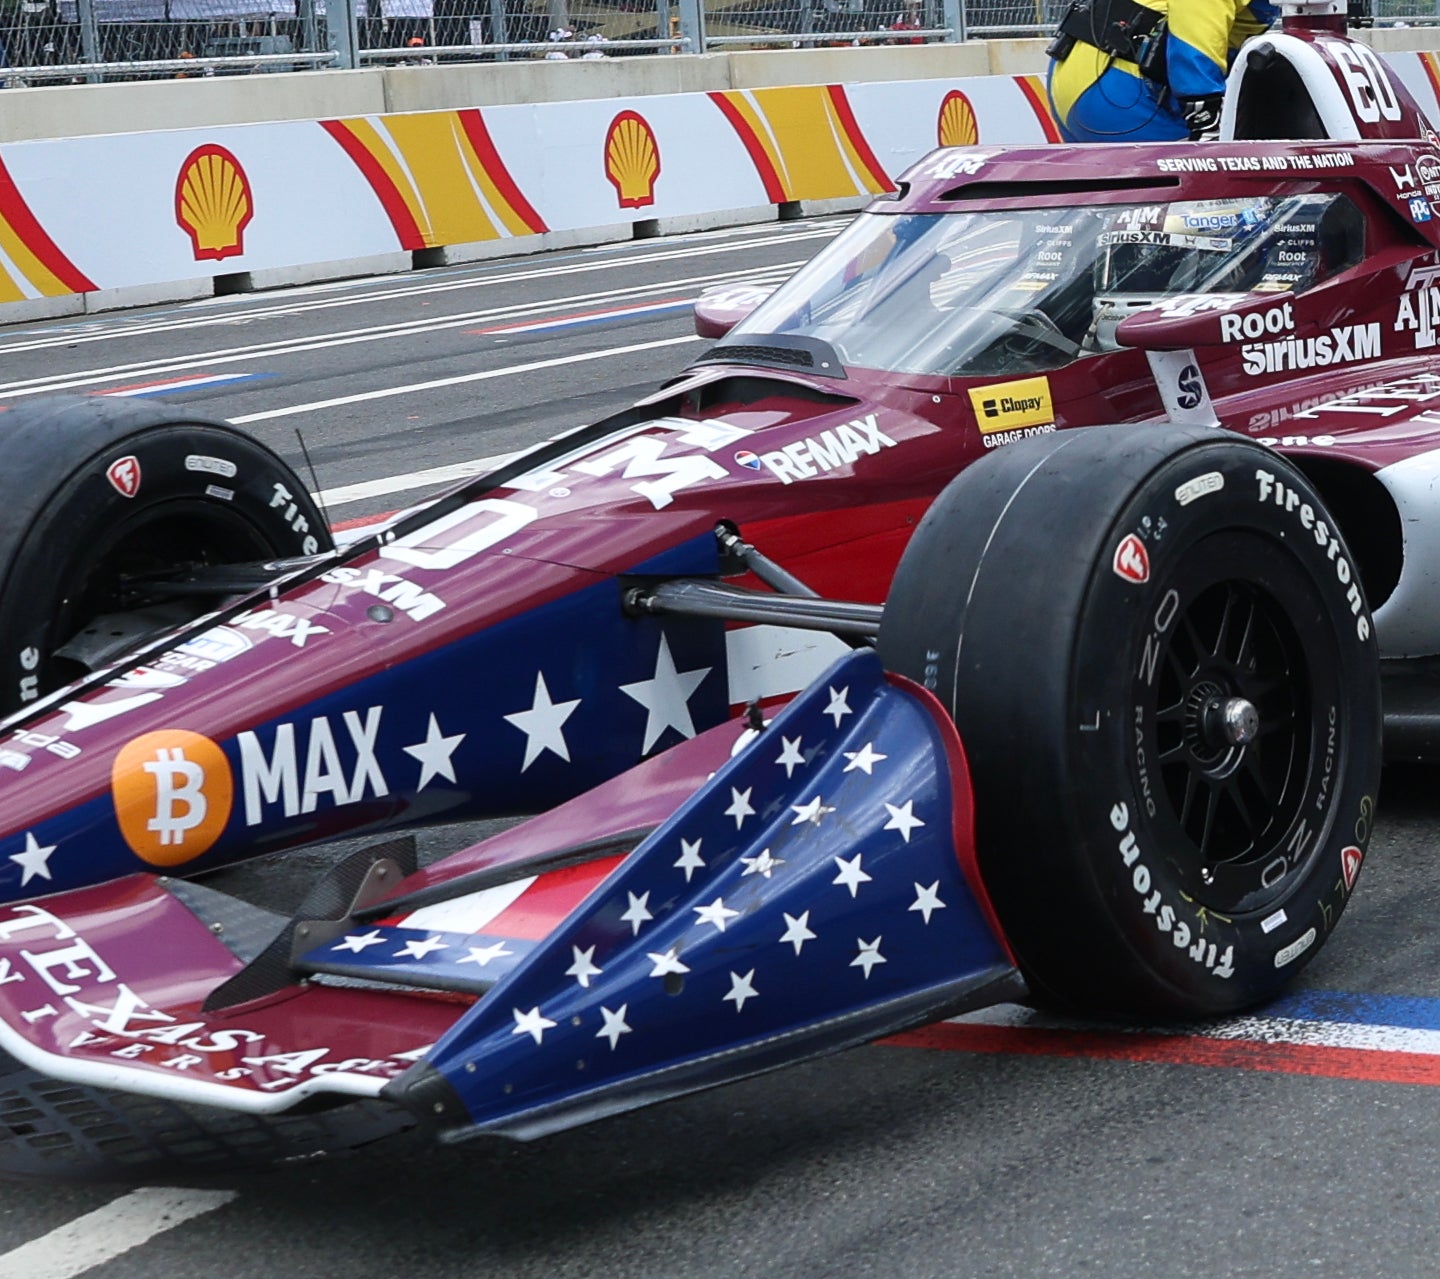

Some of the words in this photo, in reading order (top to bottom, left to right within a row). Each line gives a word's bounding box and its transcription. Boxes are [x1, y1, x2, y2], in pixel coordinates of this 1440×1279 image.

[1327, 41, 1401, 123] 60
[1157, 158, 1217, 172] SERVING
[1217, 157, 1261, 171] TEXAS
[1262, 156, 1289, 170] AND
[1289, 155, 1313, 169] THE
[1314, 152, 1354, 168] NATION
[1396, 190, 1422, 200] Honda
[1035, 224, 1073, 234] SiriusXM
[1181, 213, 1236, 230] Tanger
[1274, 223, 1315, 234] SiriusXM
[1101, 230, 1170, 246] SiriusXM
[1287, 239, 1314, 247] CLIFFS
[1037, 252, 1062, 262] Root
[1278, 251, 1306, 262] Root
[1221, 302, 1295, 343] Root
[1242, 323, 1381, 376] SiriusXM
[1000, 395, 1044, 413] Clopay
[983, 428, 1023, 448] GARAGE
[759, 413, 898, 486] REMAX
[268, 482, 319, 556] Fire
[1255, 469, 1371, 643] Firestone
[237, 704, 388, 827] MAX
[1134, 705, 1157, 819] RACING
[1315, 705, 1336, 811] RACING
[1109, 801, 1235, 979] Firestone
